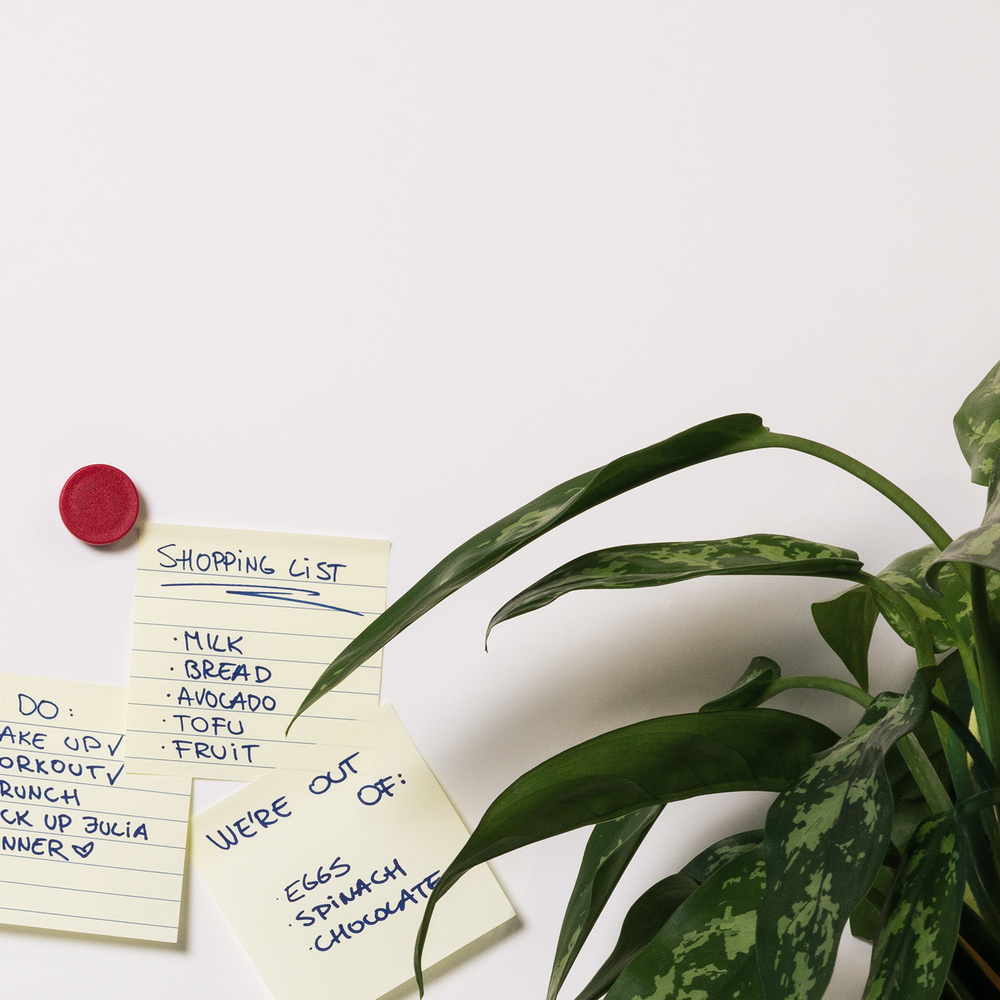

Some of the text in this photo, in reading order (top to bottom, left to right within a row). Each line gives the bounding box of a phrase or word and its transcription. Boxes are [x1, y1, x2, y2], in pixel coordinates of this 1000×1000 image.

[184, 630, 244, 656] MILK
[184, 659, 272, 684] BREAD
[177, 686, 277, 712] AVOCADO
[172, 714, 245, 736] TOFU
[63, 735, 102, 753] UP
[205, 751, 361, 851] WE'RE OUT
[44, 813, 72, 834] UP
[284, 856, 352, 902] EGGS
[314, 869, 442, 952] CHOCOLATE
